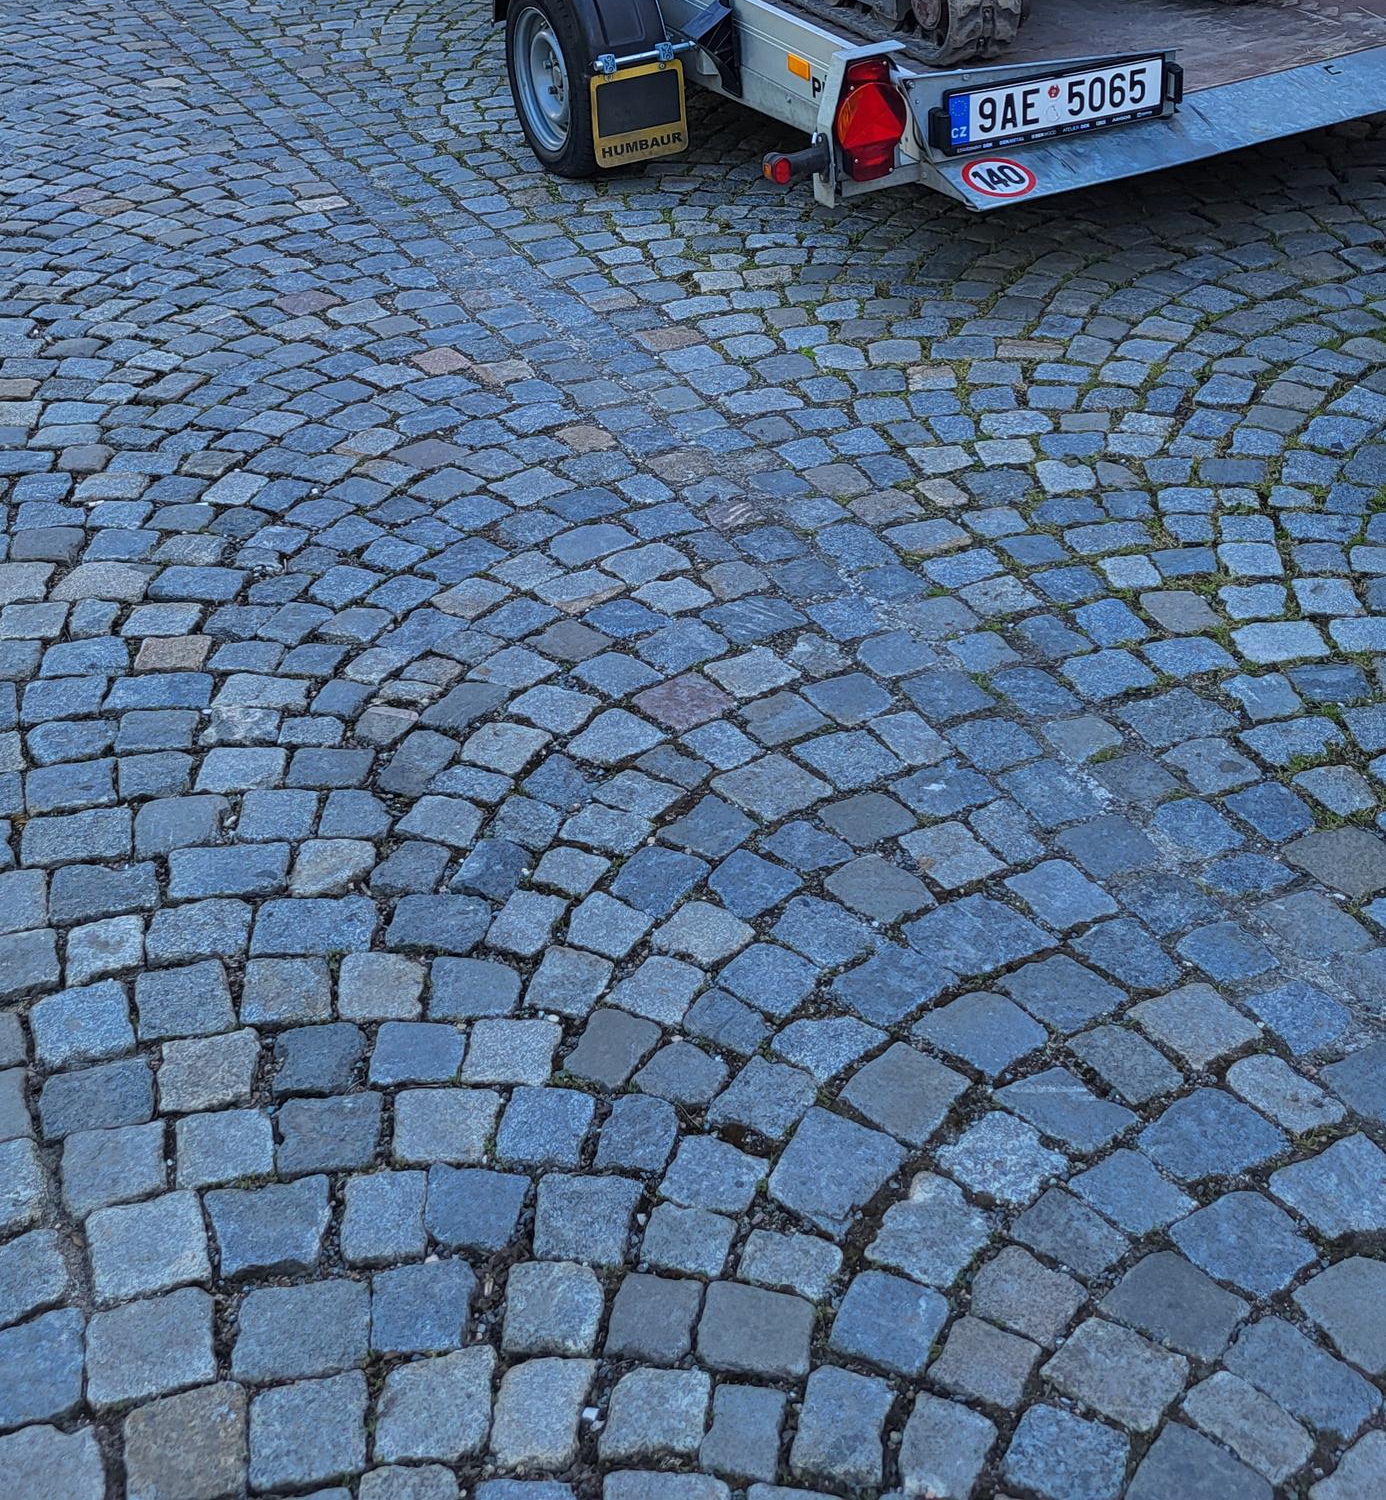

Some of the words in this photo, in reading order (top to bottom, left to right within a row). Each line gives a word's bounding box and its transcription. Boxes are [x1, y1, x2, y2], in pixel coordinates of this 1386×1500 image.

[978, 88, 1041, 134] 9AE
[1067, 67, 1147, 116] 5065
[602, 131, 682, 159] HUMBAUR
[951, 126, 967, 138] CZ
[971, 165, 1026, 191] 140
